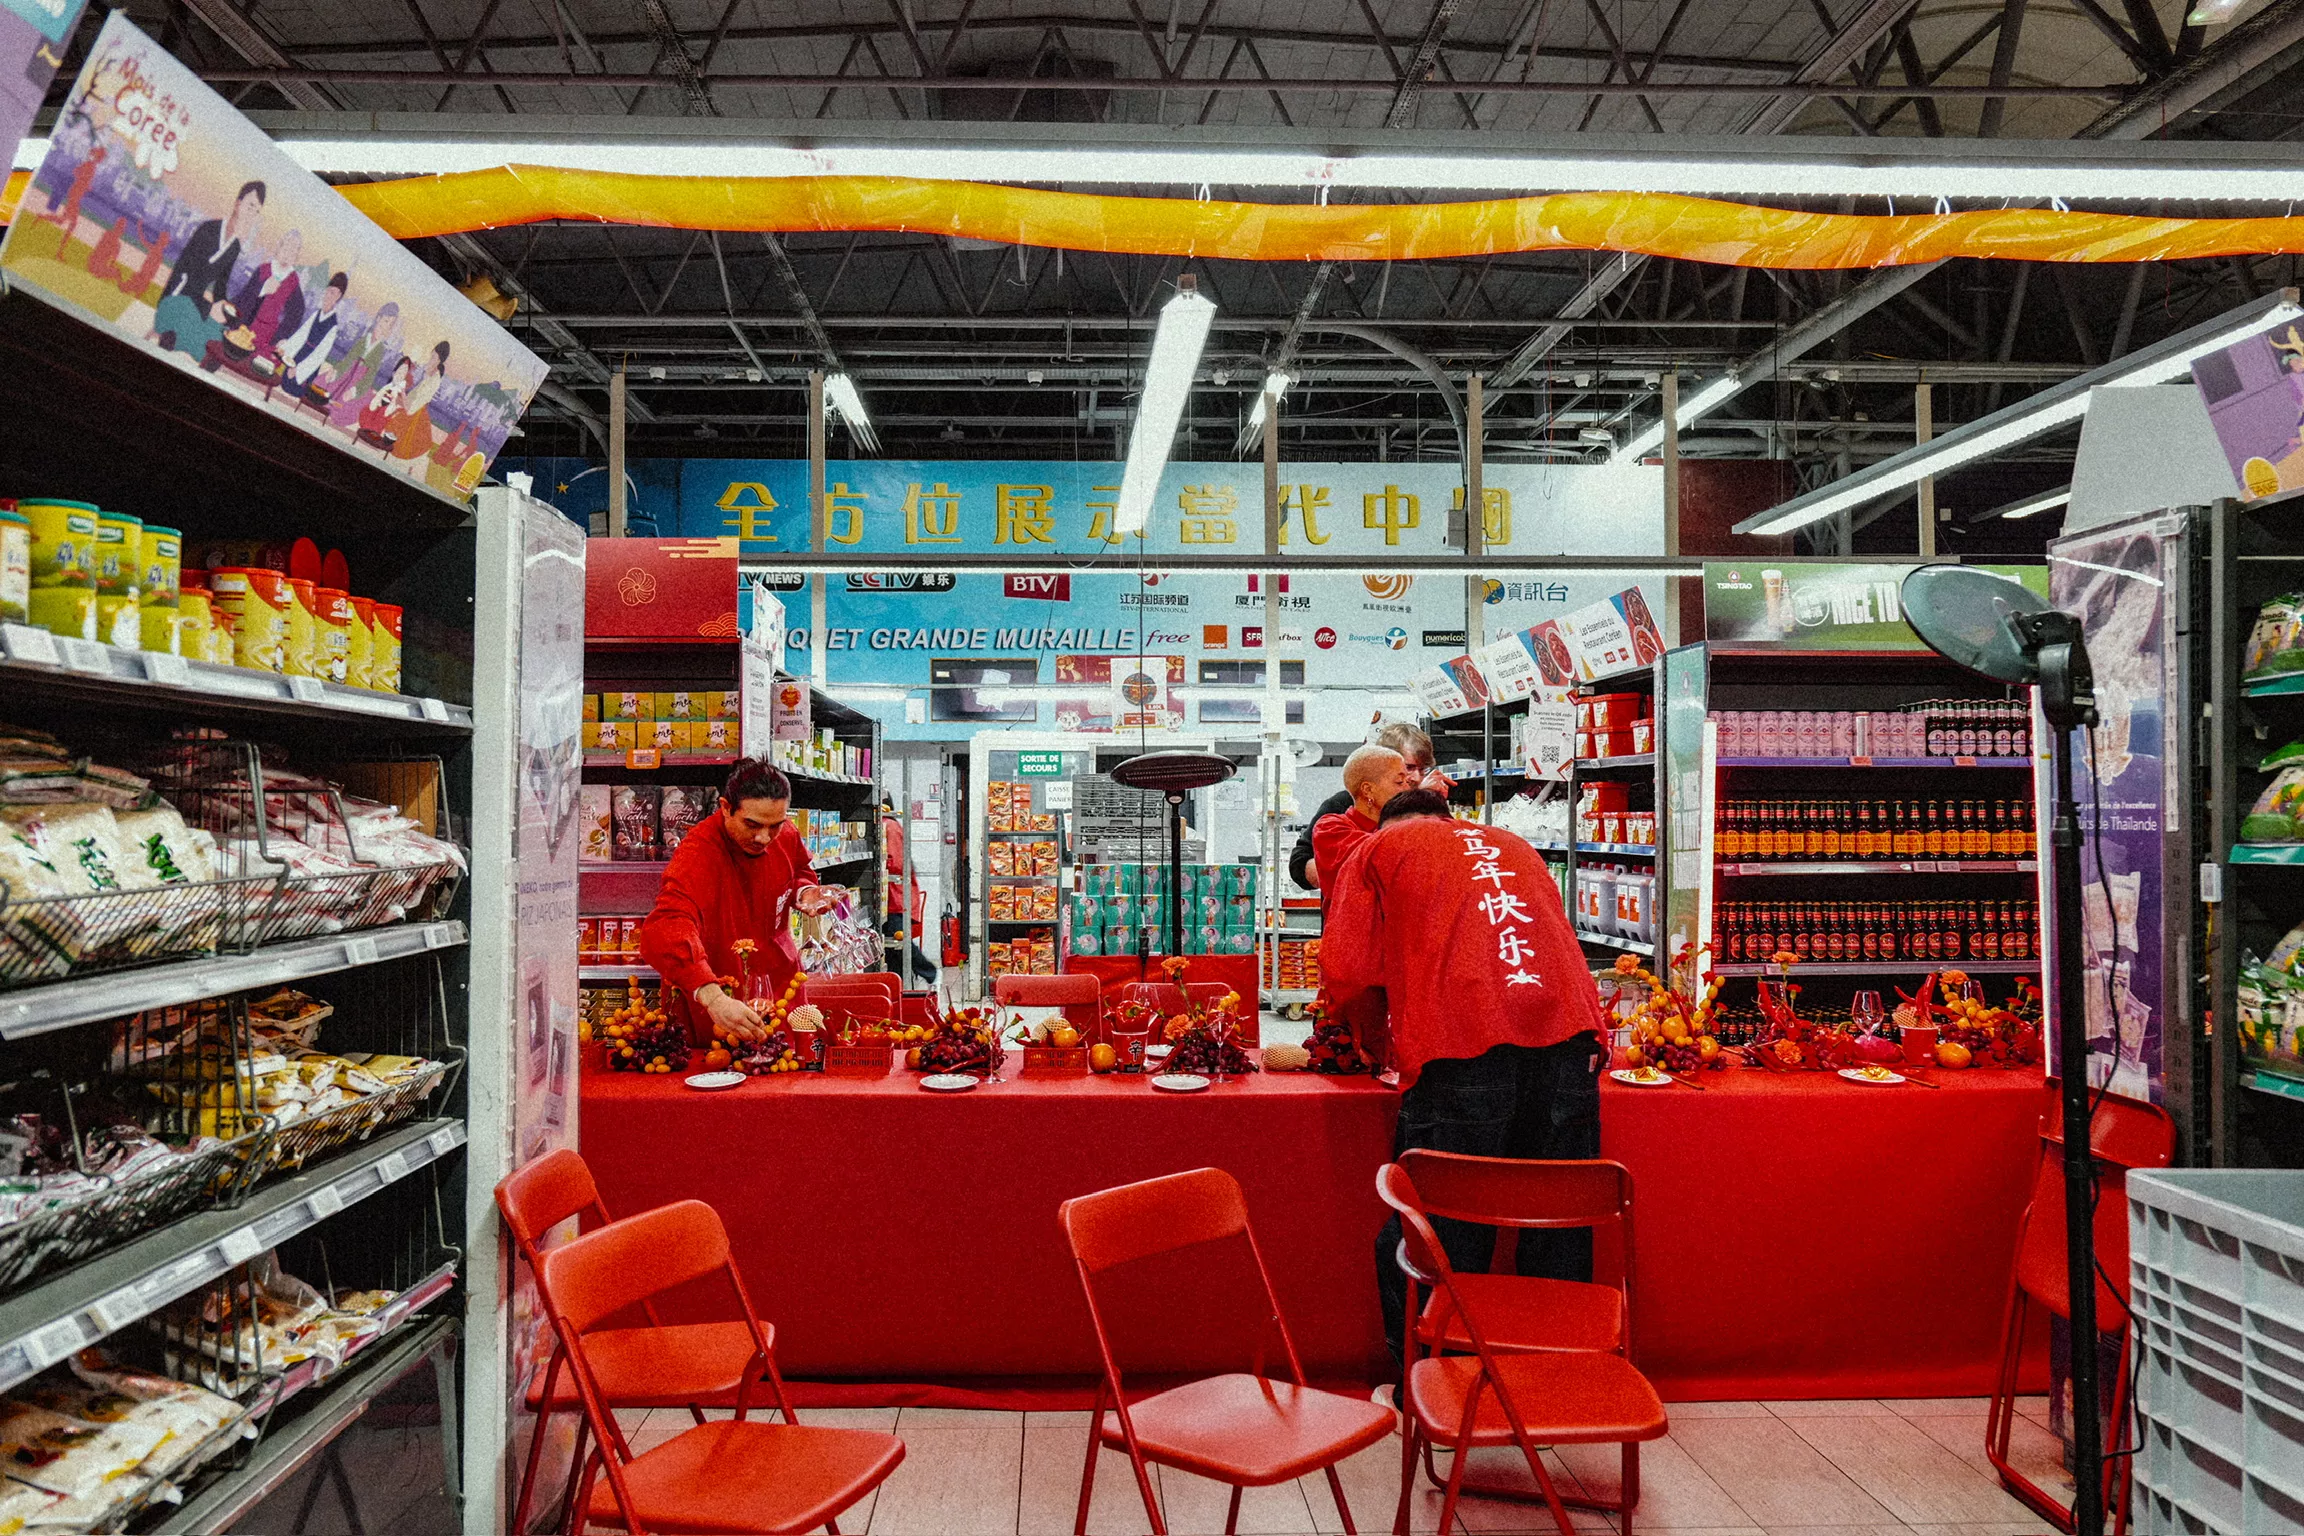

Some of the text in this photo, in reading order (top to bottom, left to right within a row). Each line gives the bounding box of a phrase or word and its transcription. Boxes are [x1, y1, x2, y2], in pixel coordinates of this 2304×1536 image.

[114, 82, 177, 151] Corée
[765, 573, 802, 584] NEWS
[846, 572, 917, 588] CCTV
[1012, 576, 1057, 592] BTV
[1716, 582, 1753, 590] TSINGTAO
[1831, 583, 1874, 625] NICE
[870, 627, 989, 650] GRANDE
[995, 627, 1136, 650] MURAILLE
[1146, 629, 1191, 647] free
[1246, 632, 1263, 641] SFR
[1349, 633, 1384, 643] Bouygues
[1020, 755, 1060, 763] SORTIE DE
[1022, 764, 1058, 773] SECOURS
[1455, 838, 1535, 967] 马年快乐
